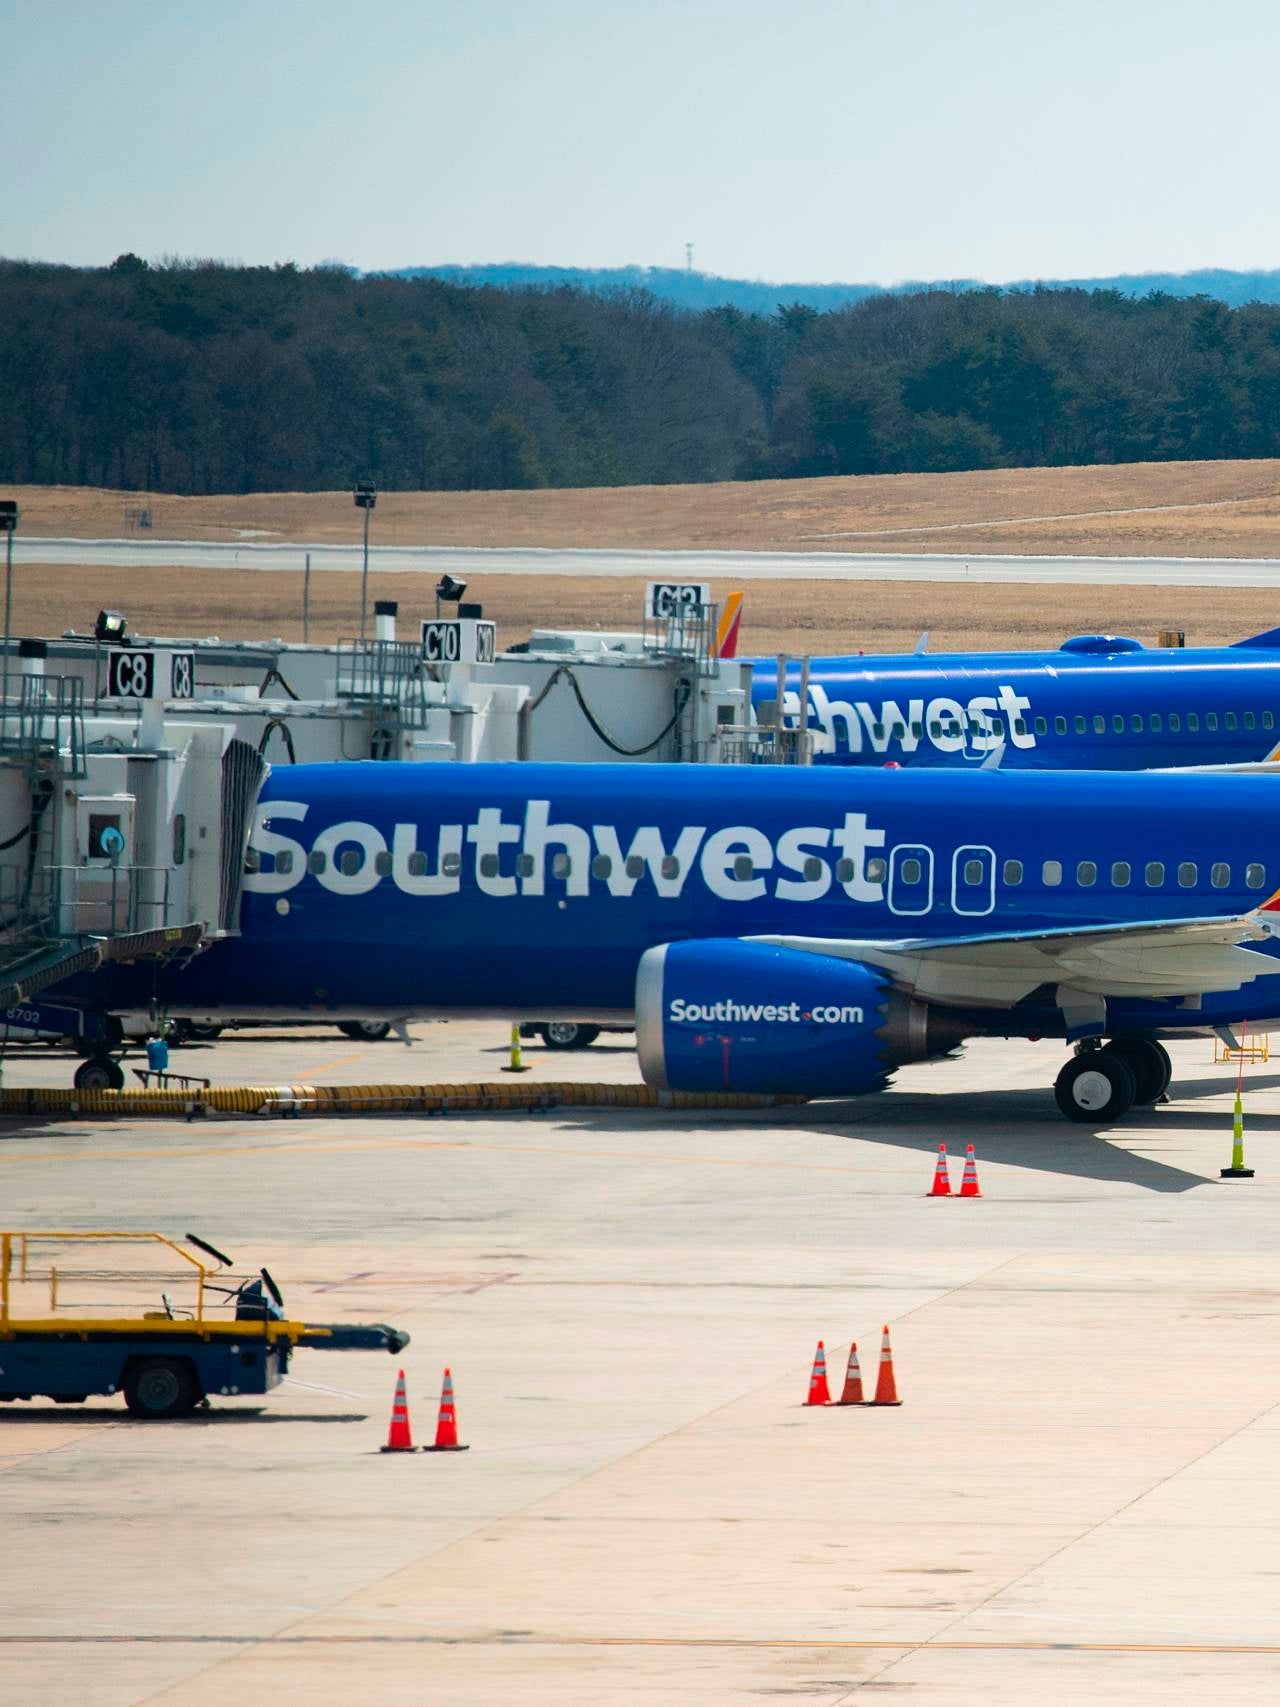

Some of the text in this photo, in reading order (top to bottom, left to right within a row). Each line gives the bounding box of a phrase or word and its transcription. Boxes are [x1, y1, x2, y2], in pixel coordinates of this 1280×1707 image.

[656, 585, 697, 617] C12
[424, 624, 458, 661] C10
[476, 625, 494, 662] C10
[116, 653, 148, 697] C8
[173, 655, 190, 698] C8
[242, 800, 887, 902] Southwest
